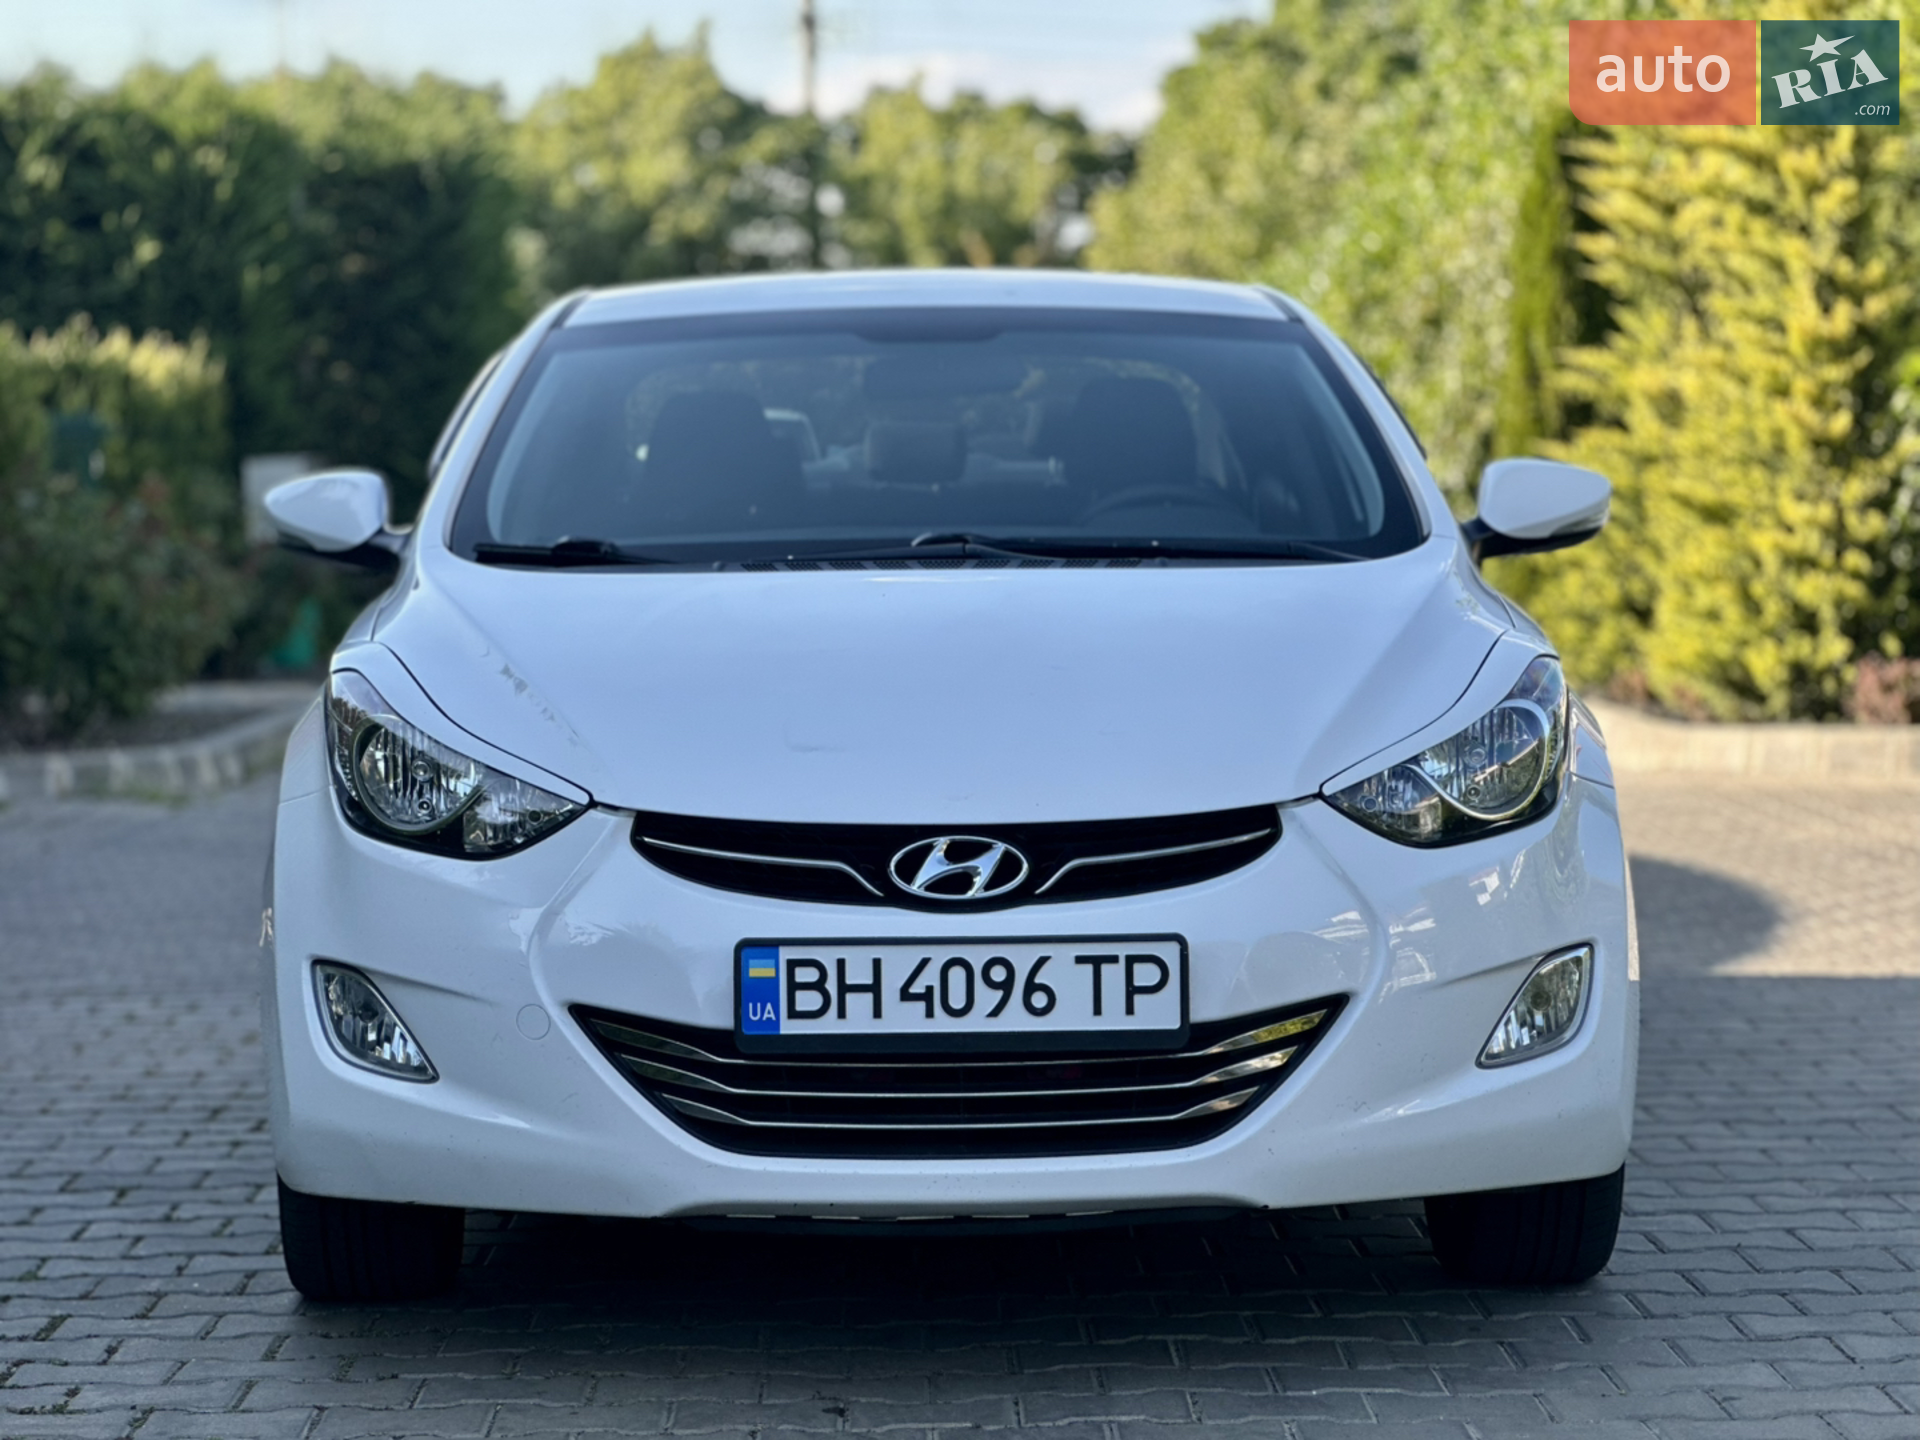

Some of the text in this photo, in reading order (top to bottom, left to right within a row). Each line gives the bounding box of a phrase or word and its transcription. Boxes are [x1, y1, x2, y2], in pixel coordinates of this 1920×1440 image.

[785, 953, 1170, 1020] BH 4096 TP
[748, 1002, 776, 1021] UA
